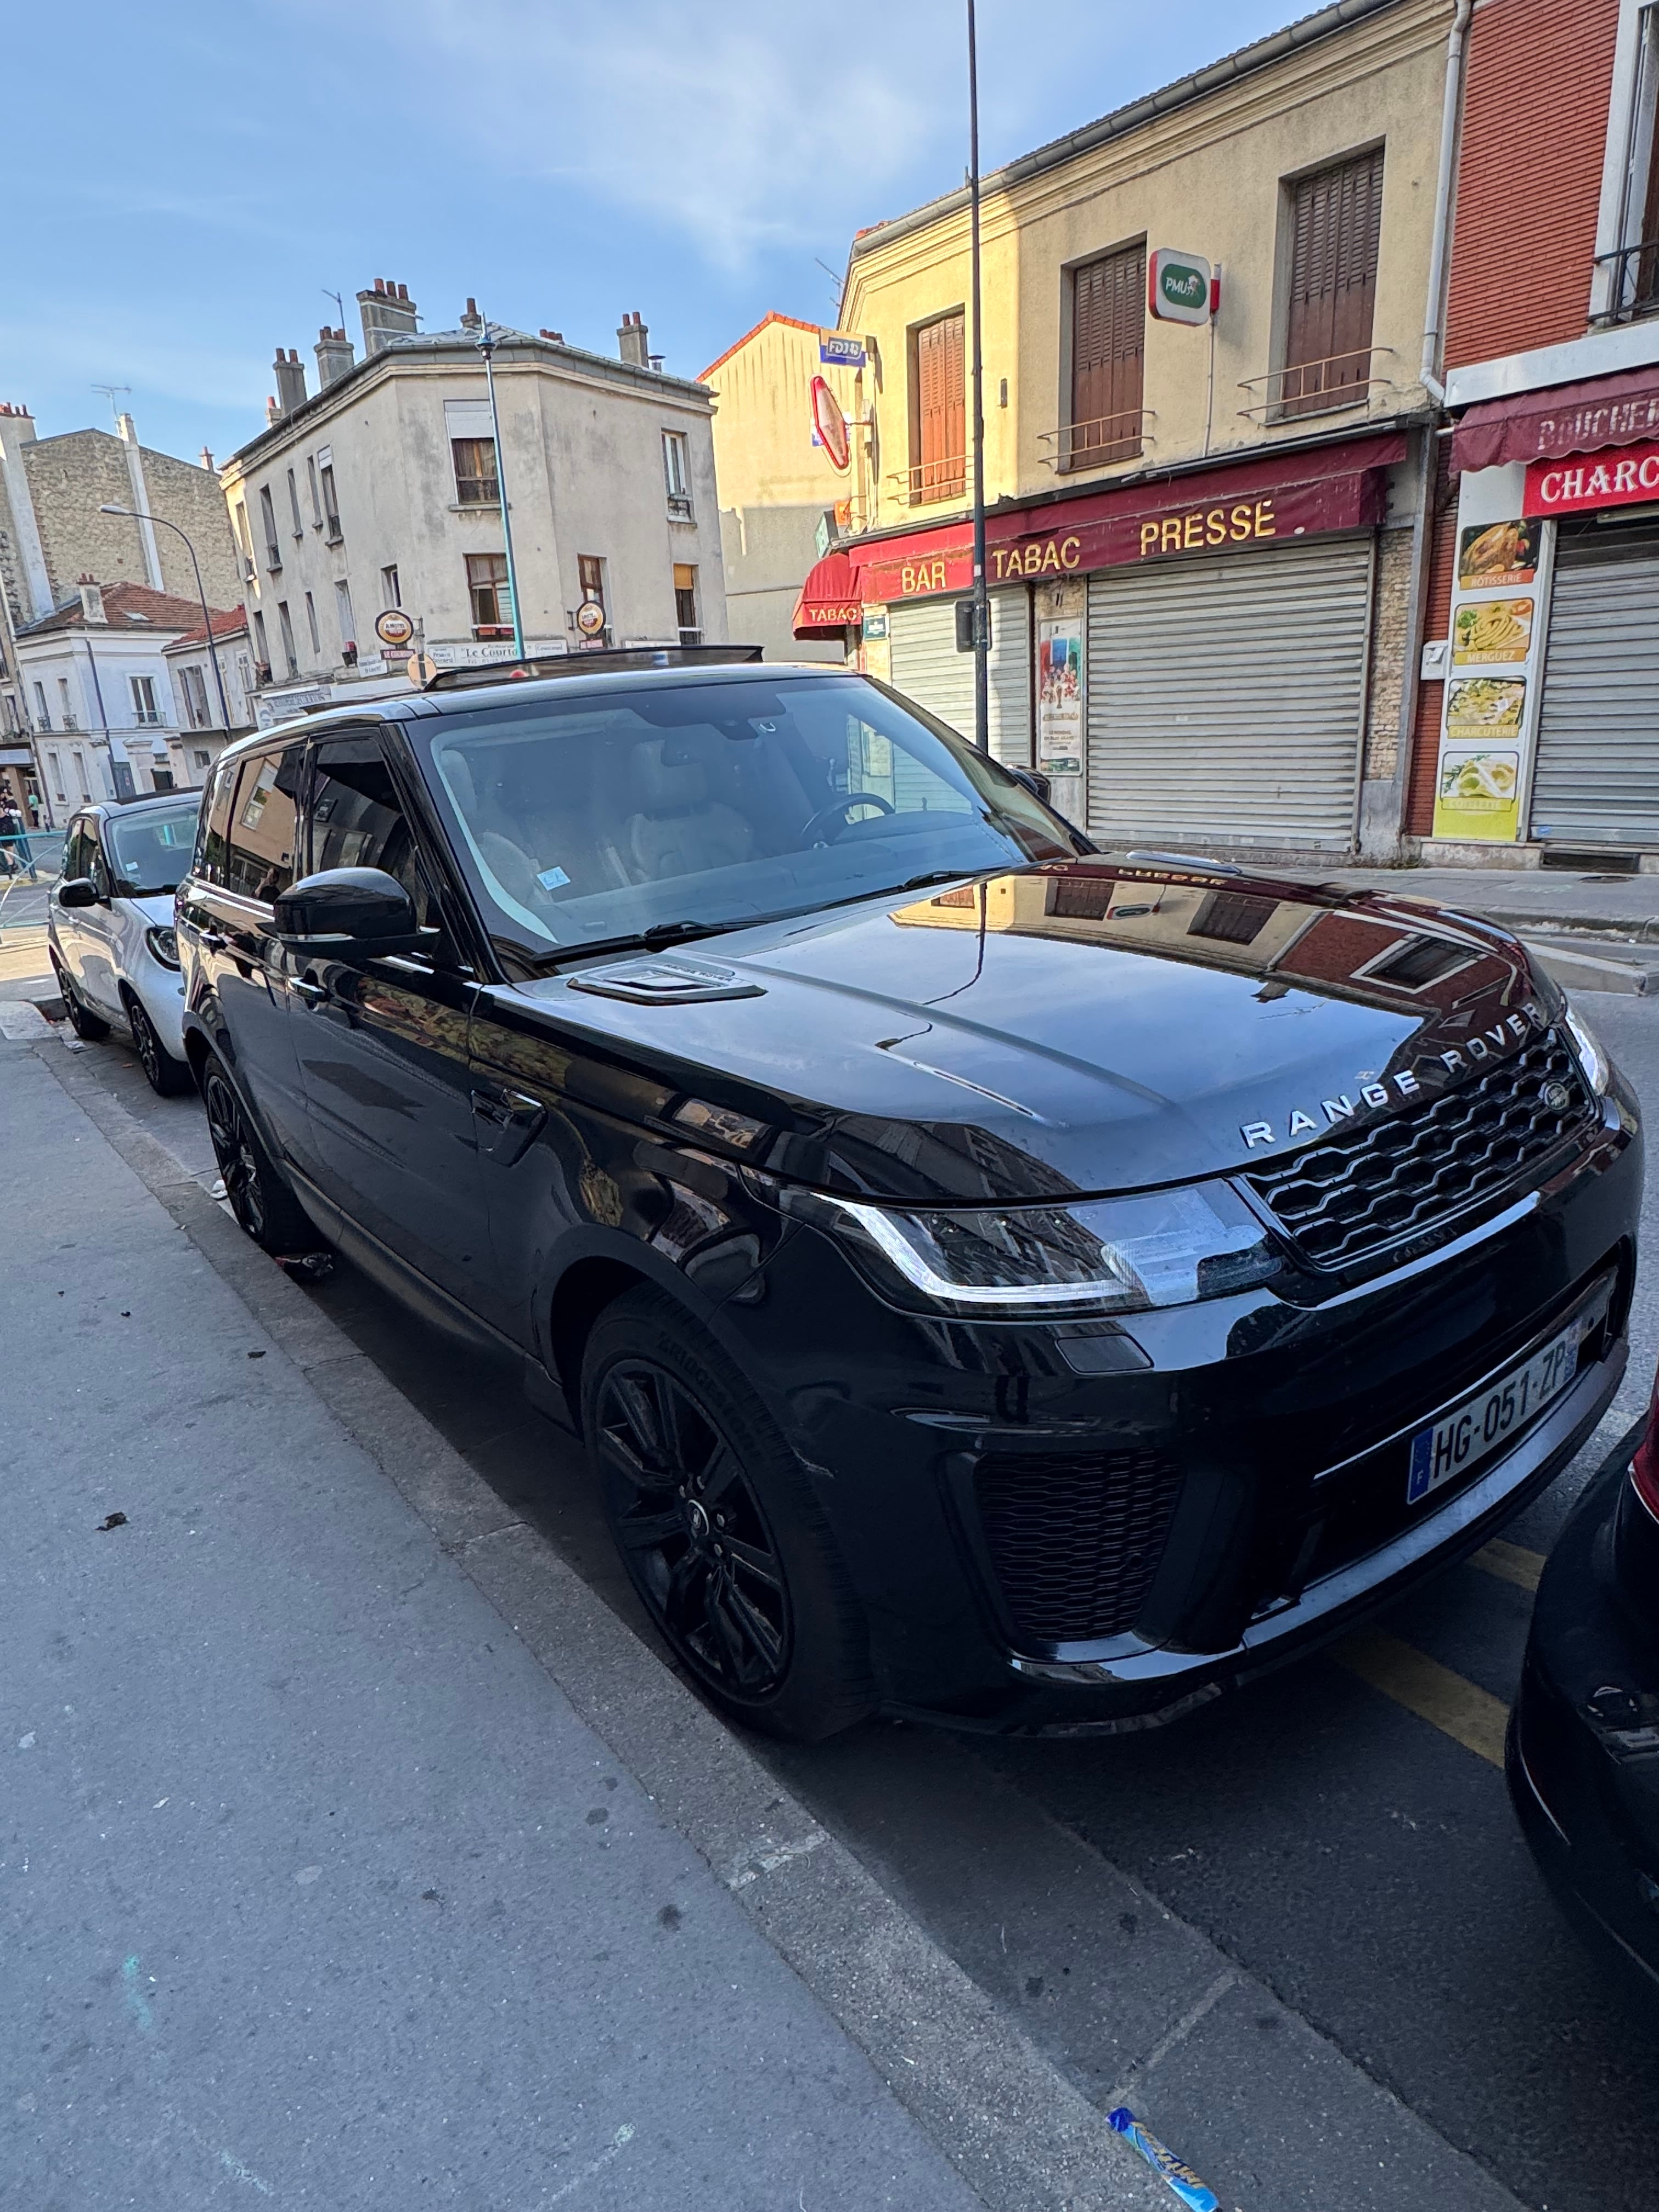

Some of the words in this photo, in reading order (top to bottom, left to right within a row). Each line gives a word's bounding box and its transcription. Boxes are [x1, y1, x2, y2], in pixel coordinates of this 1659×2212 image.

[1165, 276, 1188, 295] PMU
[830, 340, 849, 354] FDJ
[901, 561, 946, 594] BAR
[992, 537, 1081, 579] TABAC
[1140, 500, 1276, 555] PRESSE
[809, 607, 857, 622] TABAC
[482, 647, 525, 657] Courto
[1466, 651, 1515, 663] MERGUEZ
[1240, 1070, 1420, 1148] RANGE
[1440, 1002, 1543, 1073] ROVER
[1434, 1341, 1566, 1479] HG-051-ZP
[1416, 1470, 1424, 1485] F
